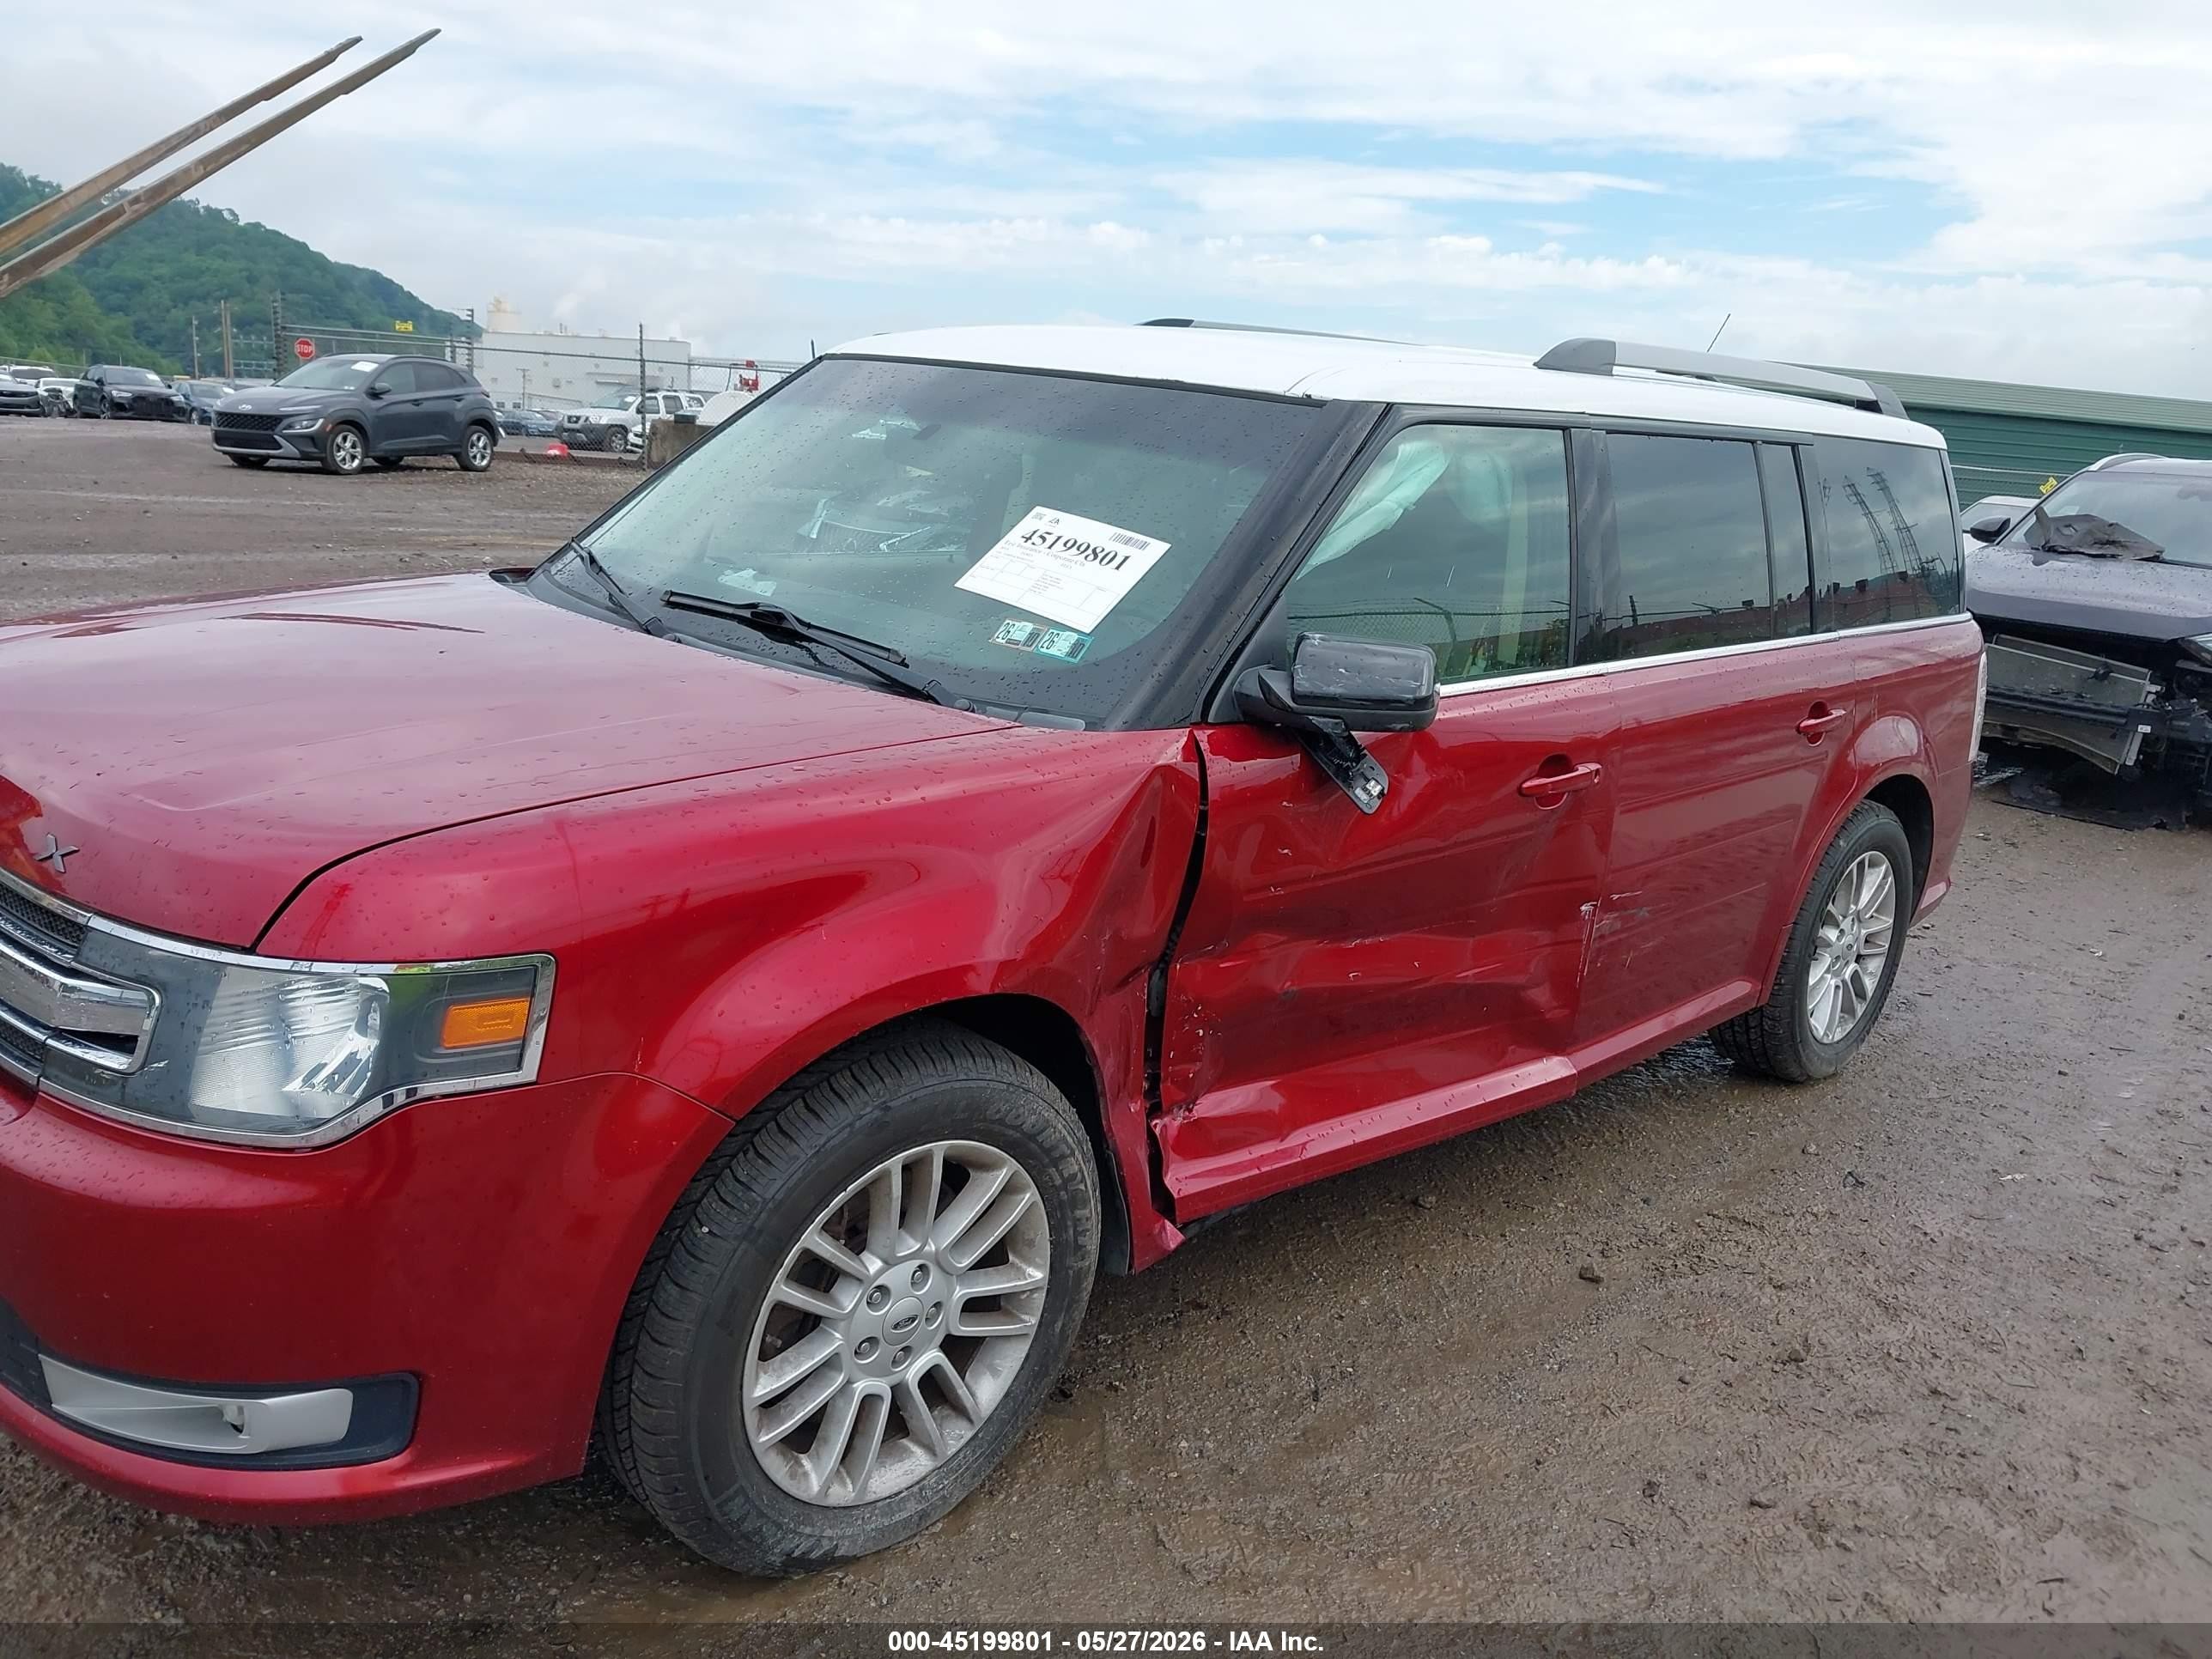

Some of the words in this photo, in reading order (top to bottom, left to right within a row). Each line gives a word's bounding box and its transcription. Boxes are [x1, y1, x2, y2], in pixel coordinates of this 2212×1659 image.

[296, 343, 313, 352] STOP
[1021, 529, 1132, 571] 45199801
[996, 622, 1015, 641] 26
[1040, 631, 1060, 650] 26
[33, 833, 80, 873] X
